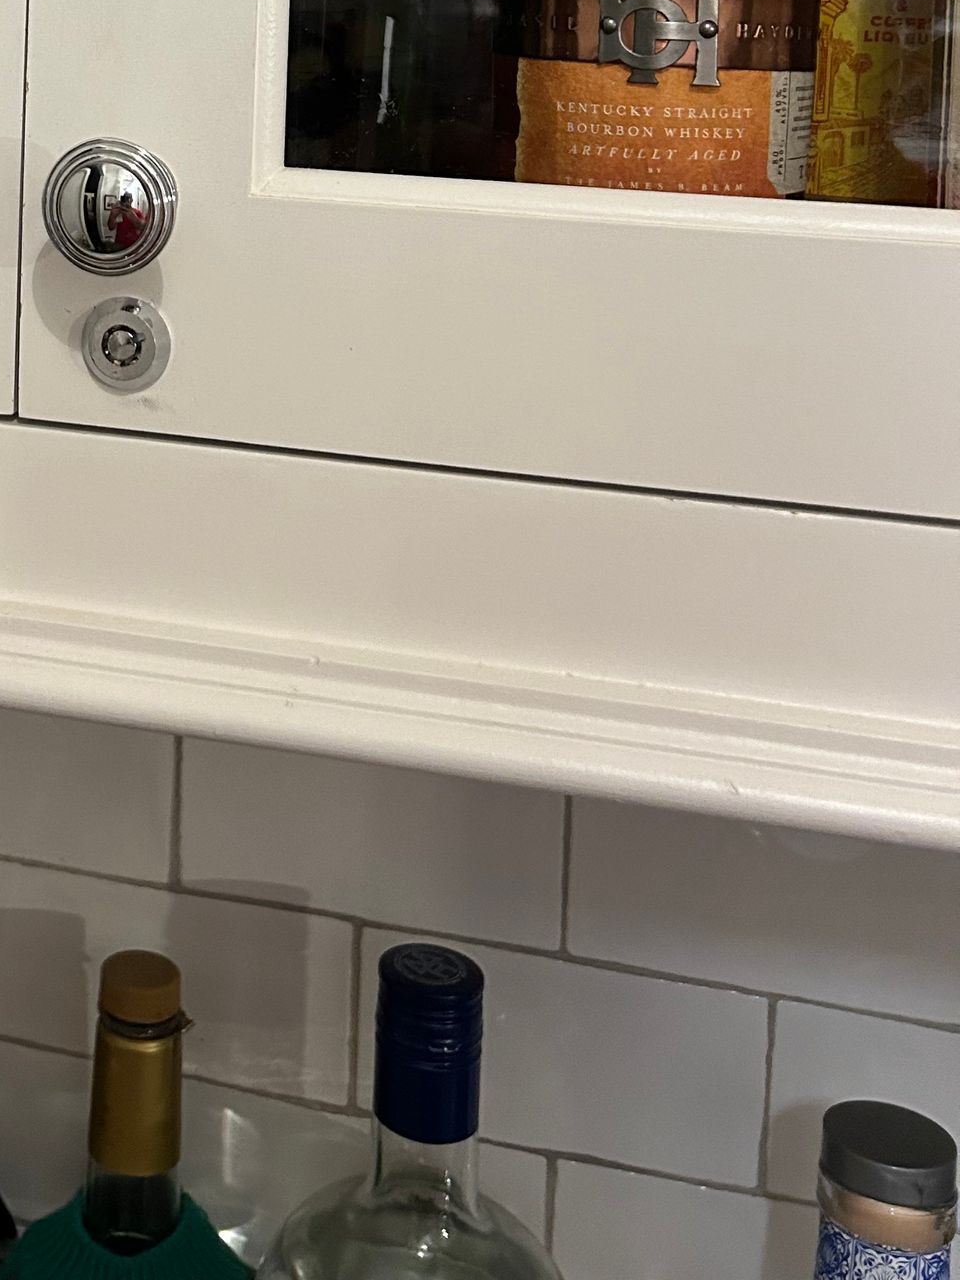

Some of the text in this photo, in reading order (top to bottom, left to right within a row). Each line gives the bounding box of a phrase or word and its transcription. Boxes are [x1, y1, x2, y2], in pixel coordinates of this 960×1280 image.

[556, 101, 753, 119] KENTUCKY STRAIGHT
[567, 122, 745, 139] BOURBON WHISKEY
[568, 144, 742, 161] ARTFULLY AGED
[702, 183, 744, 192] BEAM
